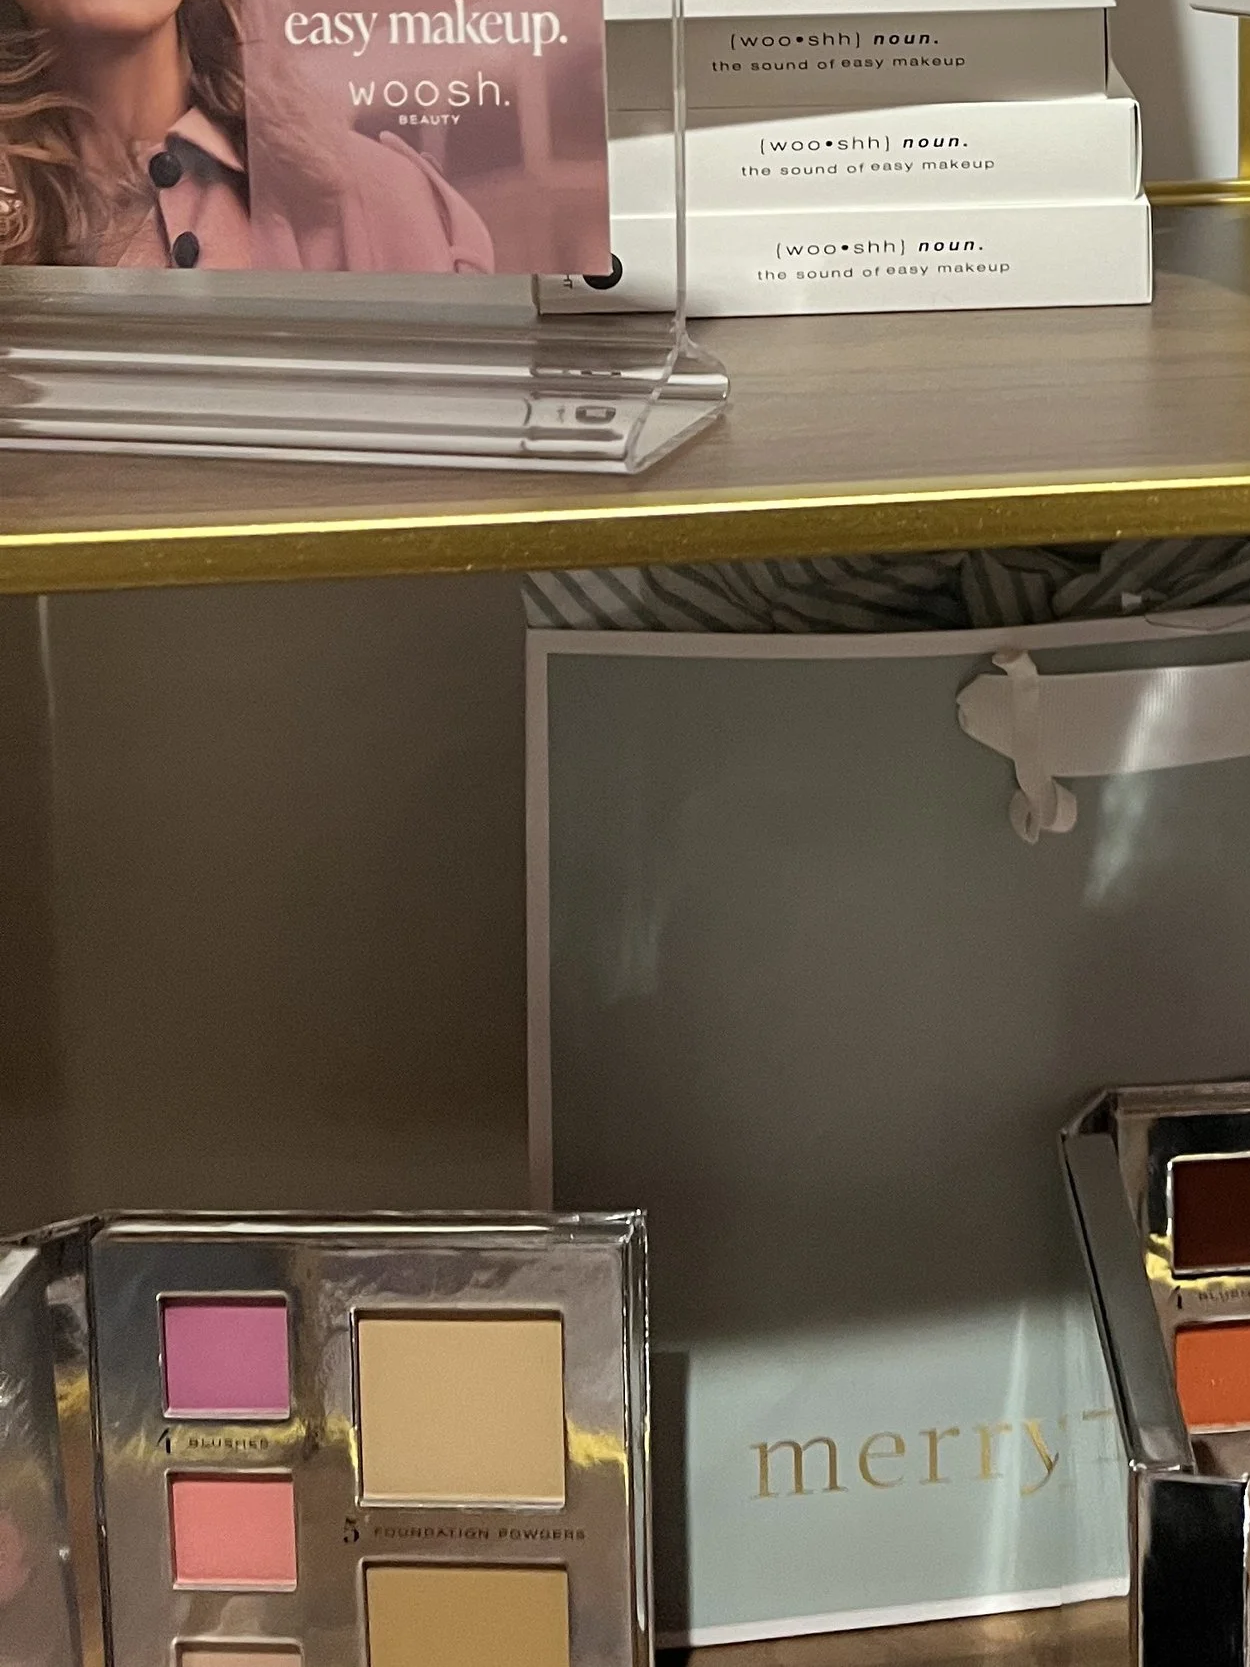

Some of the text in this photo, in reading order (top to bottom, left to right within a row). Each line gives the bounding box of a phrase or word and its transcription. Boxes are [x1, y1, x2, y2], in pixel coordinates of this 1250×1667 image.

[284, 10, 378, 57] easy
[873, 33, 940, 46] noun.
[712, 55, 966, 72] the sound of easy makeup
[349, 71, 511, 107] woosh.
[399, 114, 461, 126] BEAUTY
[902, 136, 969, 150] noun.
[741, 158, 996, 177] the sound of easy makeup
[918, 239, 985, 253] noun.
[757, 261, 1011, 281] the sound of easy makeup
[749, 1416, 1068, 1500] merry
